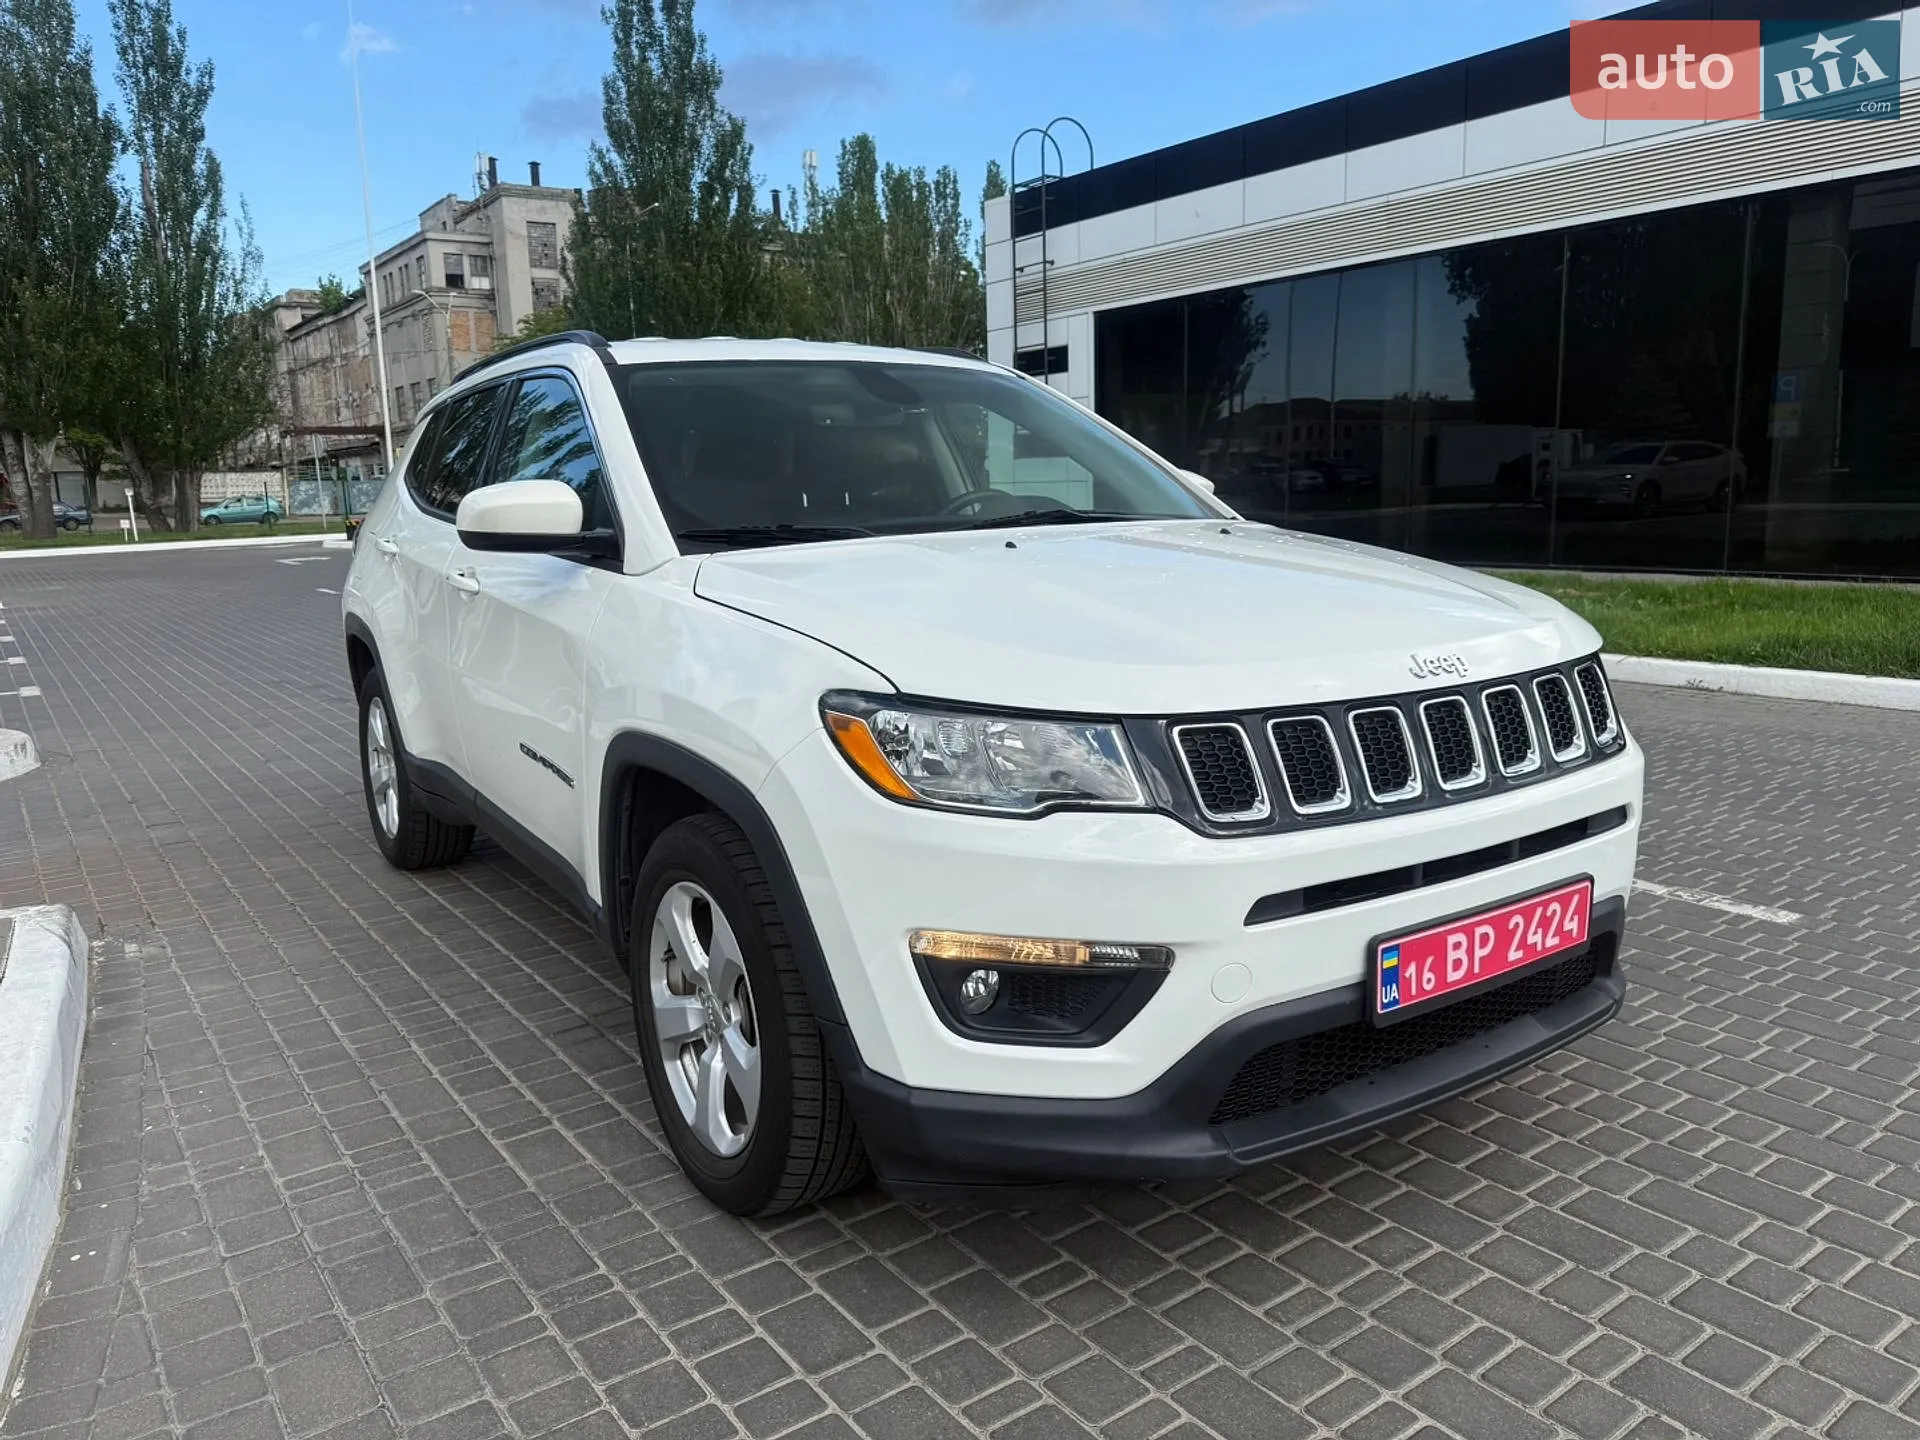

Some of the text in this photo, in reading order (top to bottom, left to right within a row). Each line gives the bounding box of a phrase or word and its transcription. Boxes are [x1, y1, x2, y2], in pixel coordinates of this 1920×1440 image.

[1408, 652, 1470, 680] Jeep
[1404, 893, 1581, 996] 16 BP 2424
[1382, 982, 1400, 1004] UA
